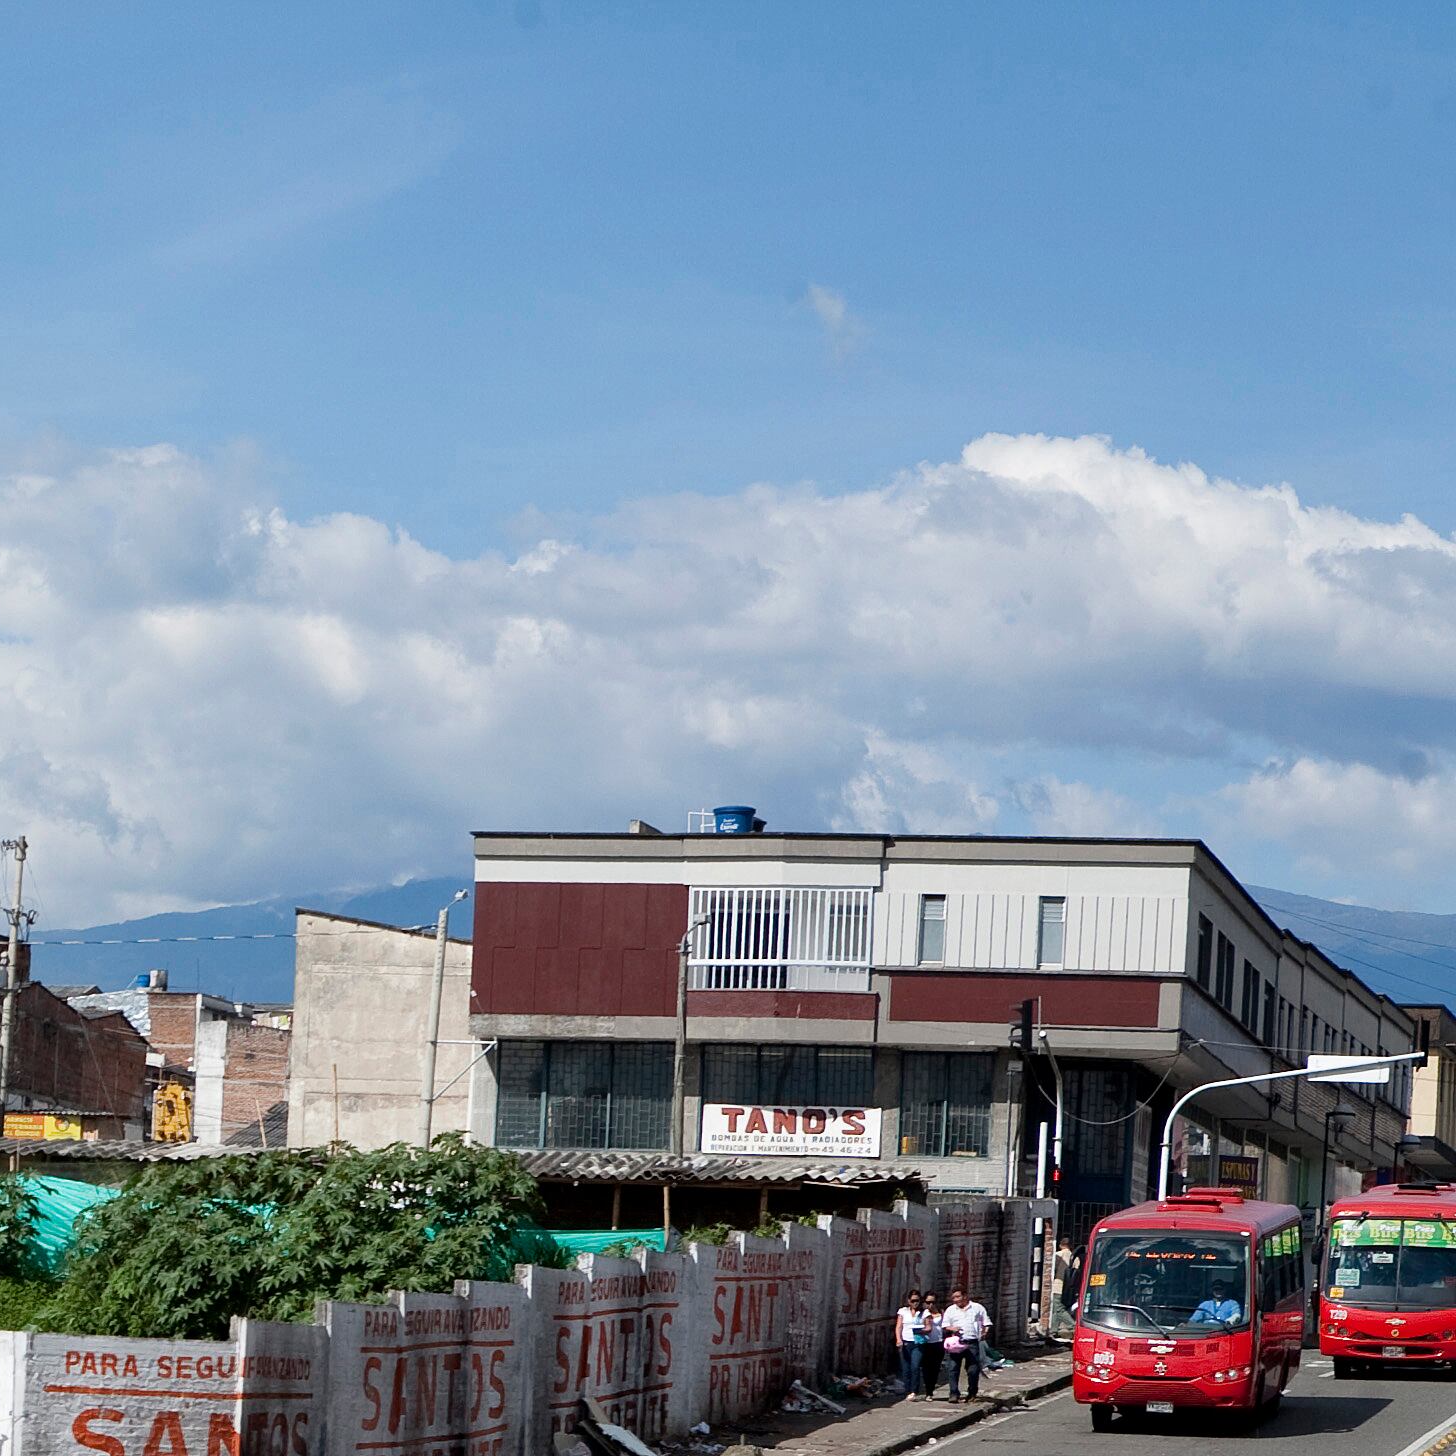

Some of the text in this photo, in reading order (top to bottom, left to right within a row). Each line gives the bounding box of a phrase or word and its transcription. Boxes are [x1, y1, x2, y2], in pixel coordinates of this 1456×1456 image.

[721, 1107, 866, 1135] TANO'S
[711, 1134, 750, 1143] BOMBAS
[753, 1135, 765, 1143] DE
[812, 1136, 872, 1145] RADIADORES
[716, 1248, 738, 1272] PARA
[558, 1281, 585, 1305] PARA
[364, 1310, 398, 1337] PARA
[404, 1309, 443, 1337] EGUIR
[711, 1284, 810, 1346] SANT
[64, 1350, 139, 1378] PARA
